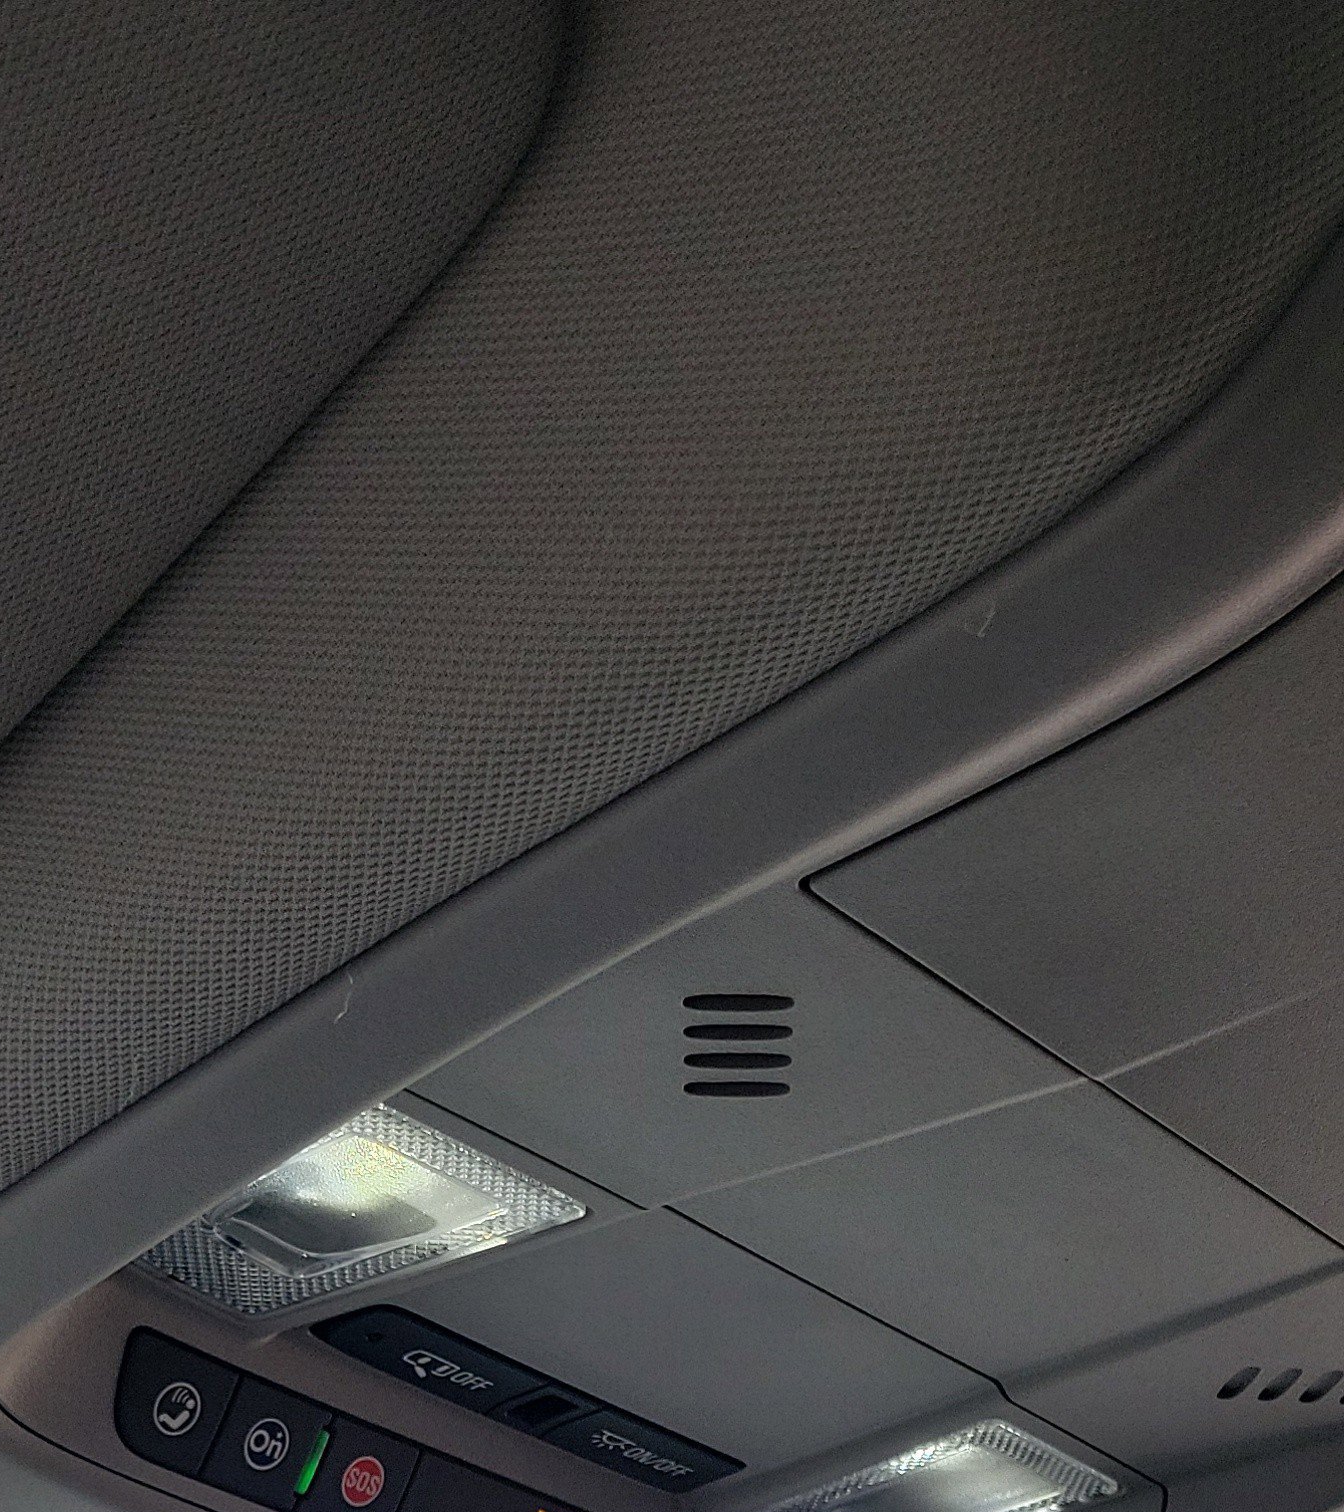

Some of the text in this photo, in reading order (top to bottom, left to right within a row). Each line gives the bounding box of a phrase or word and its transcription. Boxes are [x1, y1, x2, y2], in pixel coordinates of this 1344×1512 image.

[450, 1370, 494, 1391] OFF
[623, 1448, 694, 1477] ON/OFF
[345, 1468, 382, 1496] SOS
